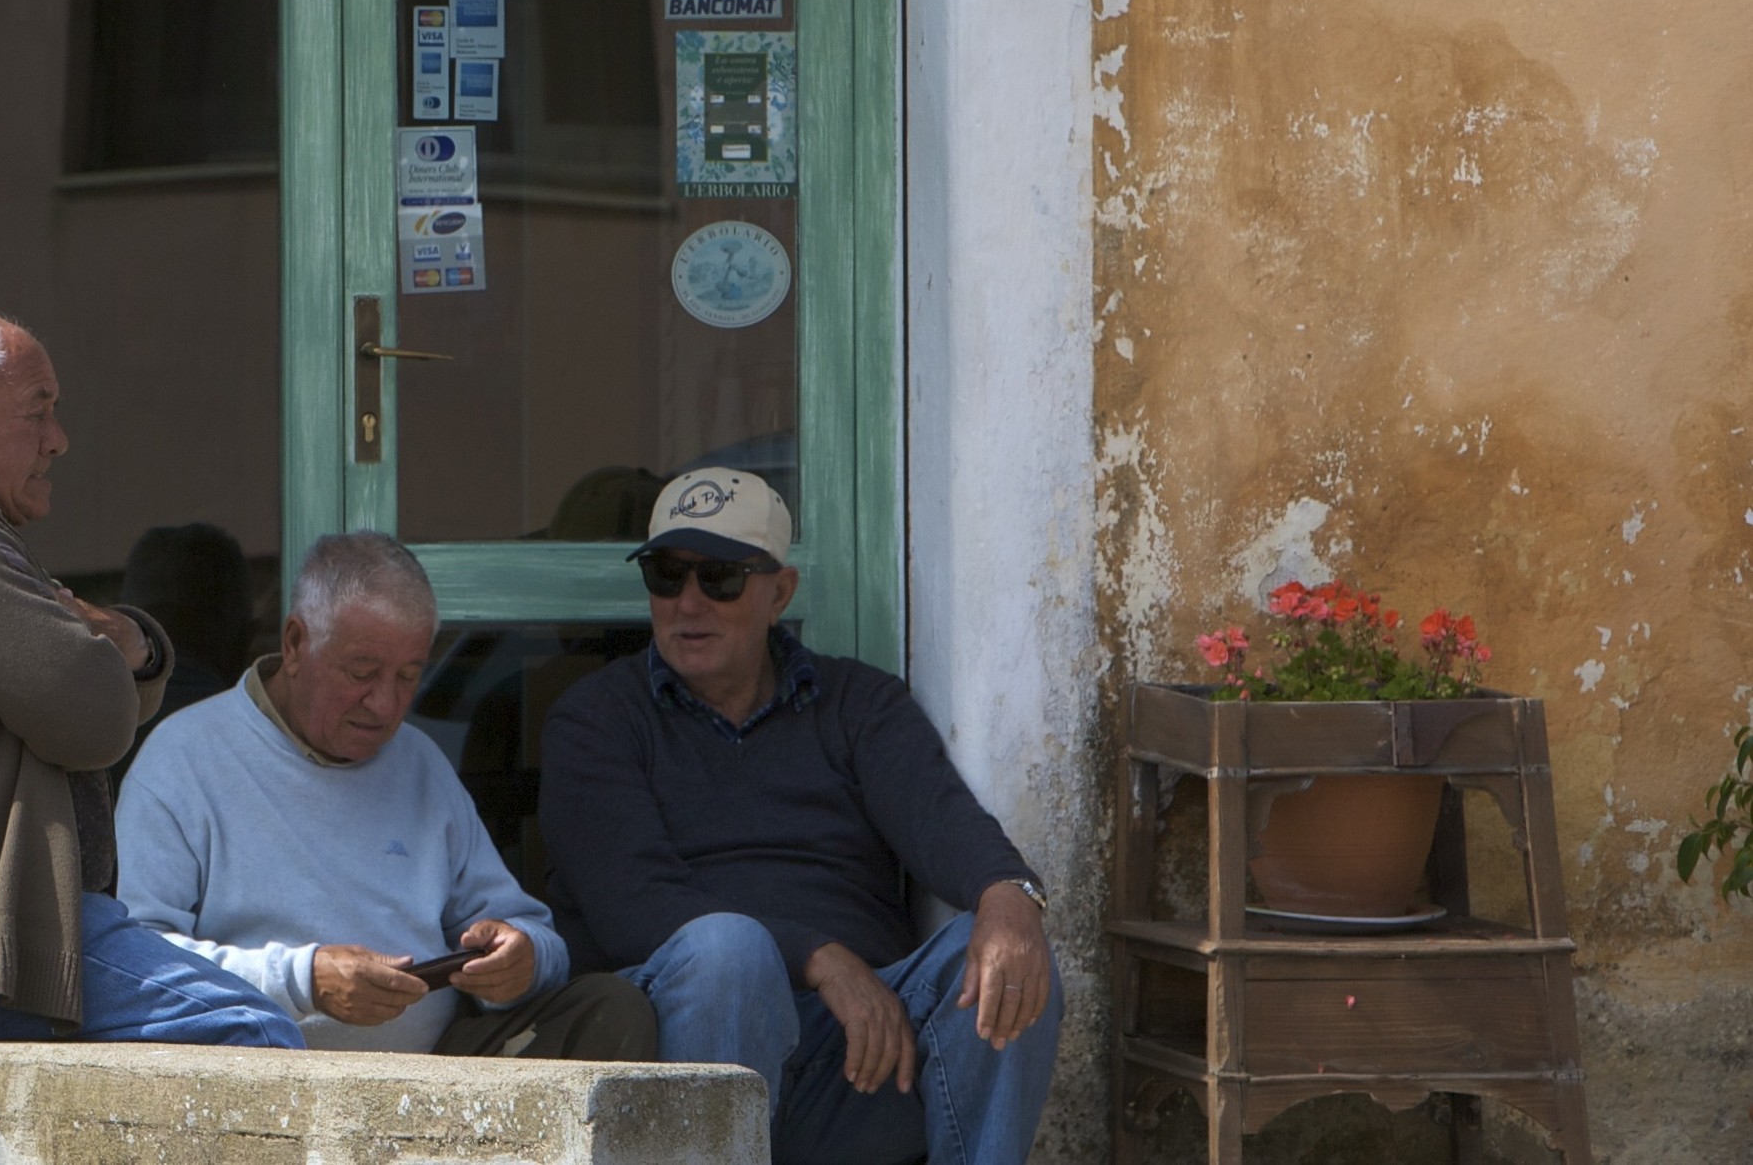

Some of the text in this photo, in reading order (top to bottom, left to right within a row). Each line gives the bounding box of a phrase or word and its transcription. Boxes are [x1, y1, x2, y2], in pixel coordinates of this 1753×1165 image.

[421, 31, 444, 41] VISA
[684, 183, 789, 198] L'ERBOLARIO
[417, 245, 439, 255] VISA
